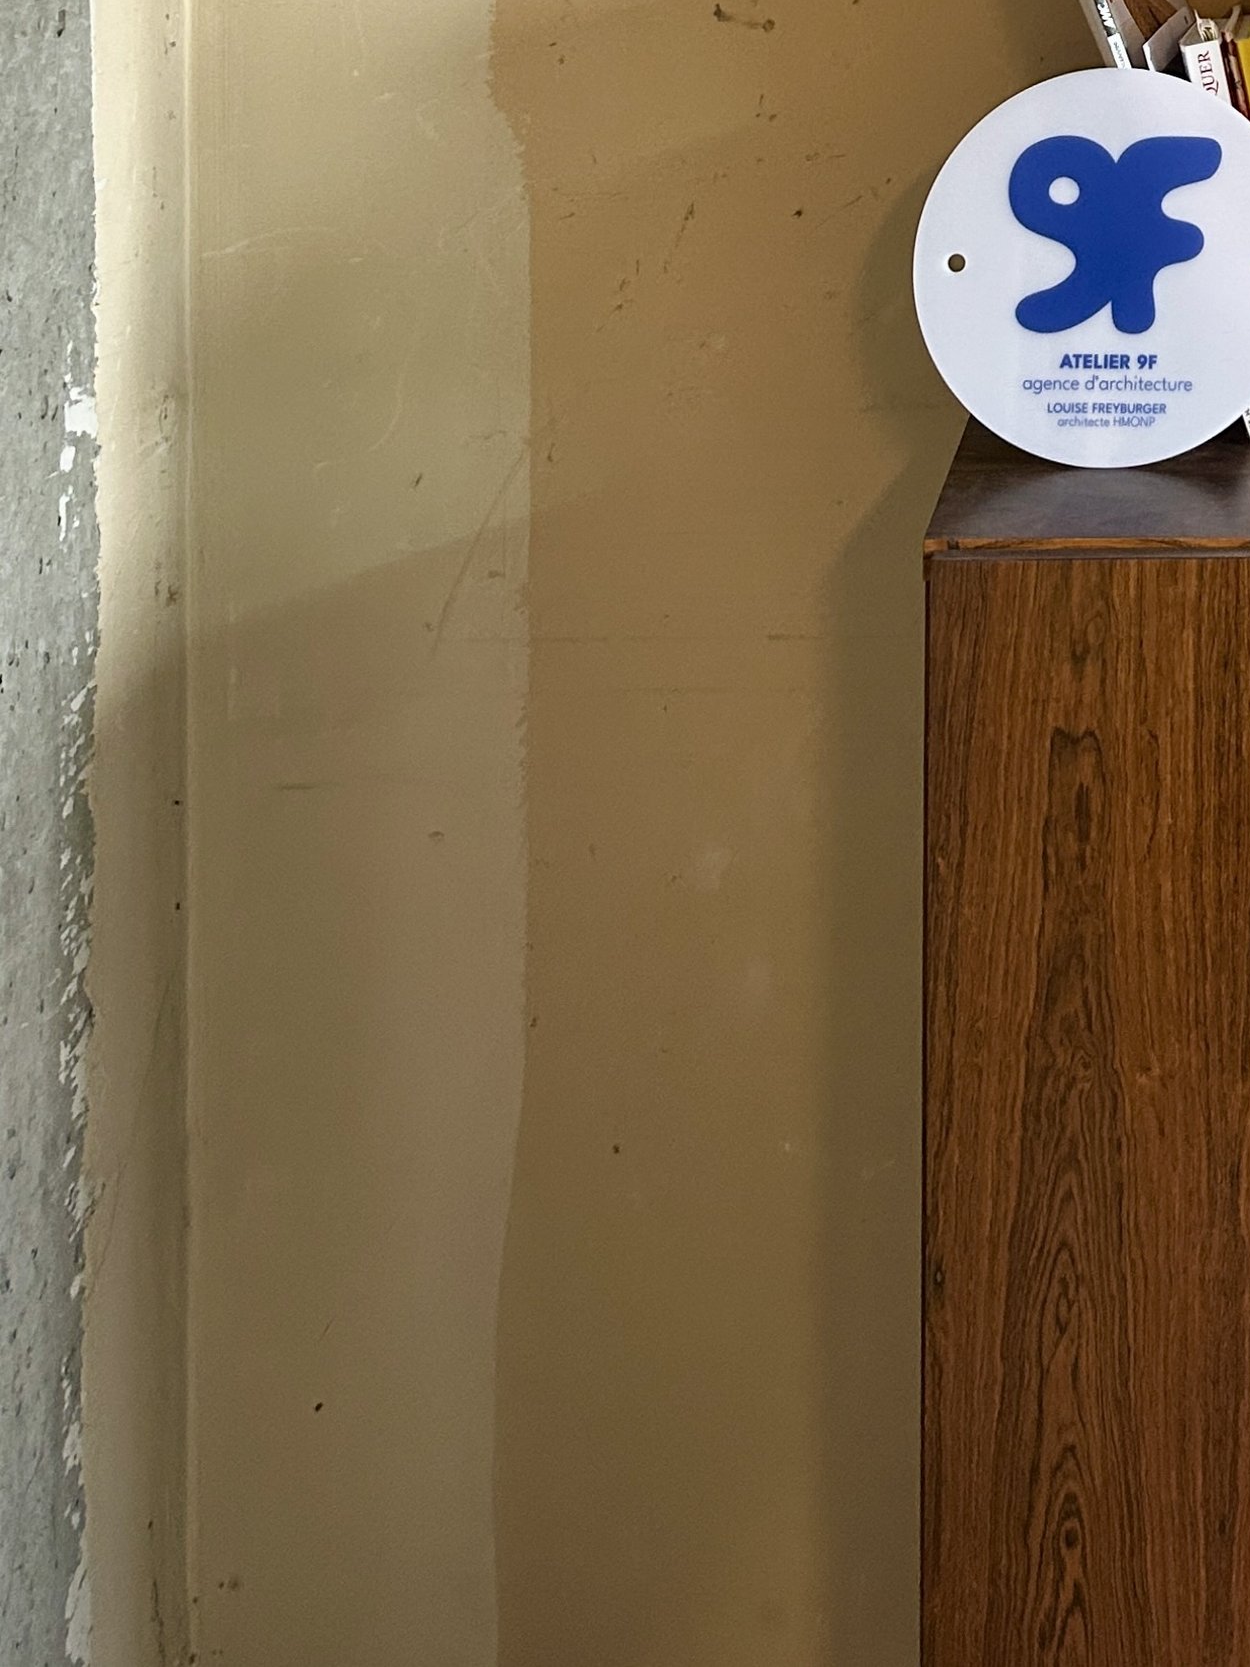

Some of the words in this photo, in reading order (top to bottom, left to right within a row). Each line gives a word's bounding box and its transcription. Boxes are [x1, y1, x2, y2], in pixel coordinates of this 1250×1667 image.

[1096, 3, 1117, 30] AMC
[1059, 353, 1131, 370] ATELIER
[1136, 353, 1158, 371] 9F
[1022, 376, 1080, 395] agence
[1084, 374, 1193, 393] d'architecture
[1047, 402, 1089, 414] LOUISE
[1091, 402, 1167, 415] FREYBURGER
[1056, 415, 1110, 428] architecte
[1112, 416, 1156, 428] HMONP
